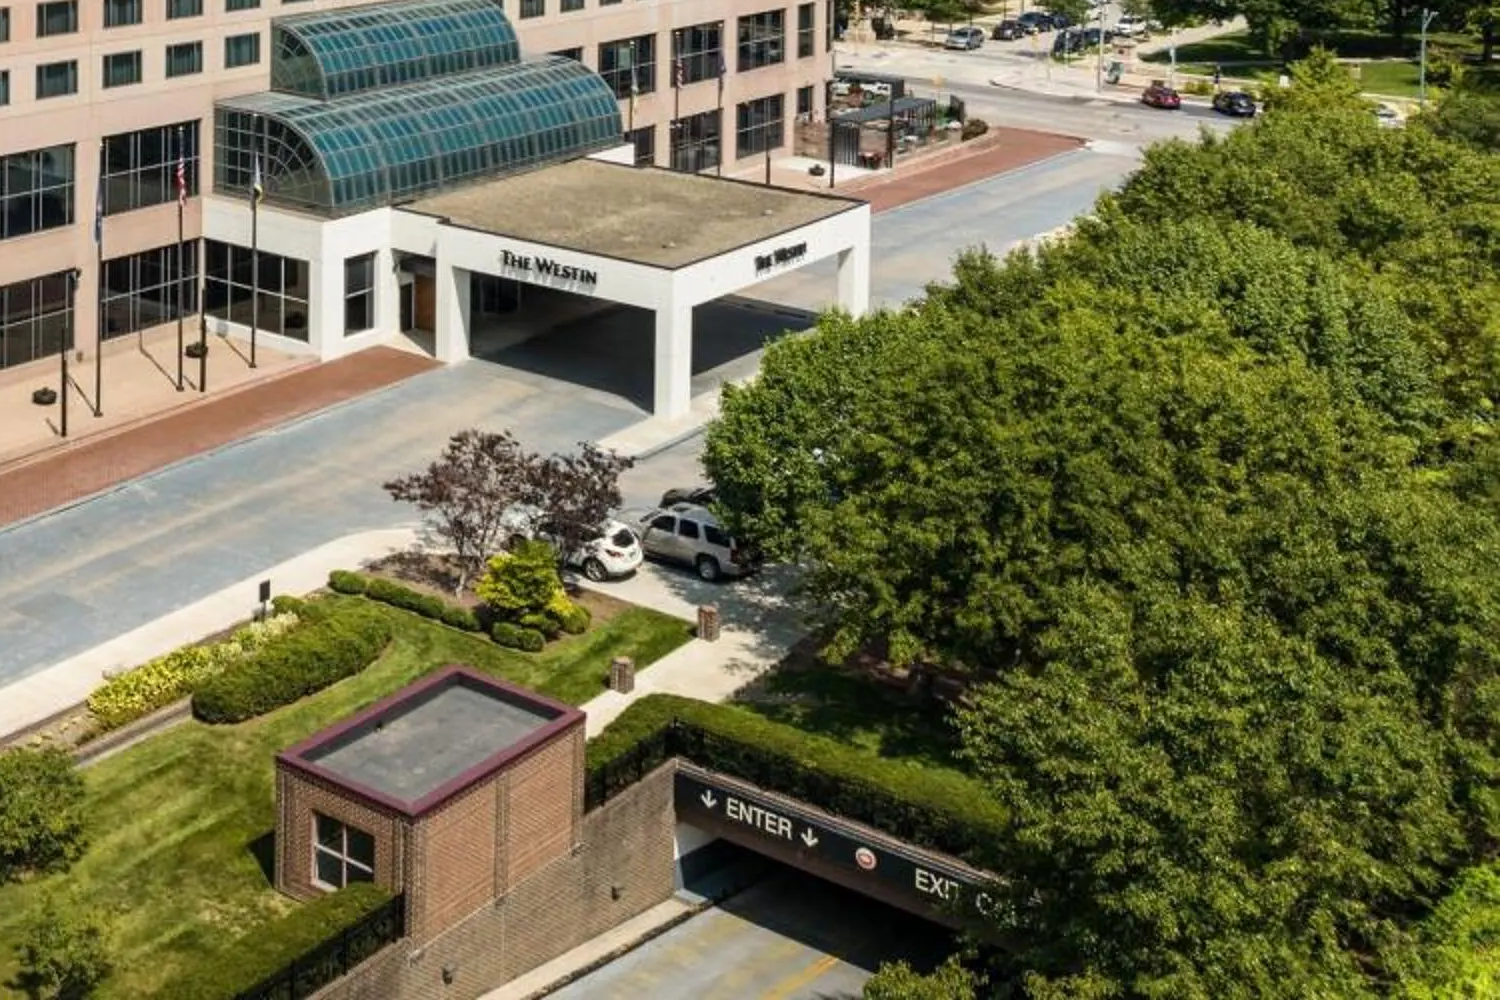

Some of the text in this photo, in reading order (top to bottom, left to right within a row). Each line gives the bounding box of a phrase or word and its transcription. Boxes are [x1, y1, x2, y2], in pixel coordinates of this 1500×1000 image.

[500, 249, 597, 284] THE WESTIN
[726, 798, 792, 840] ENTER
